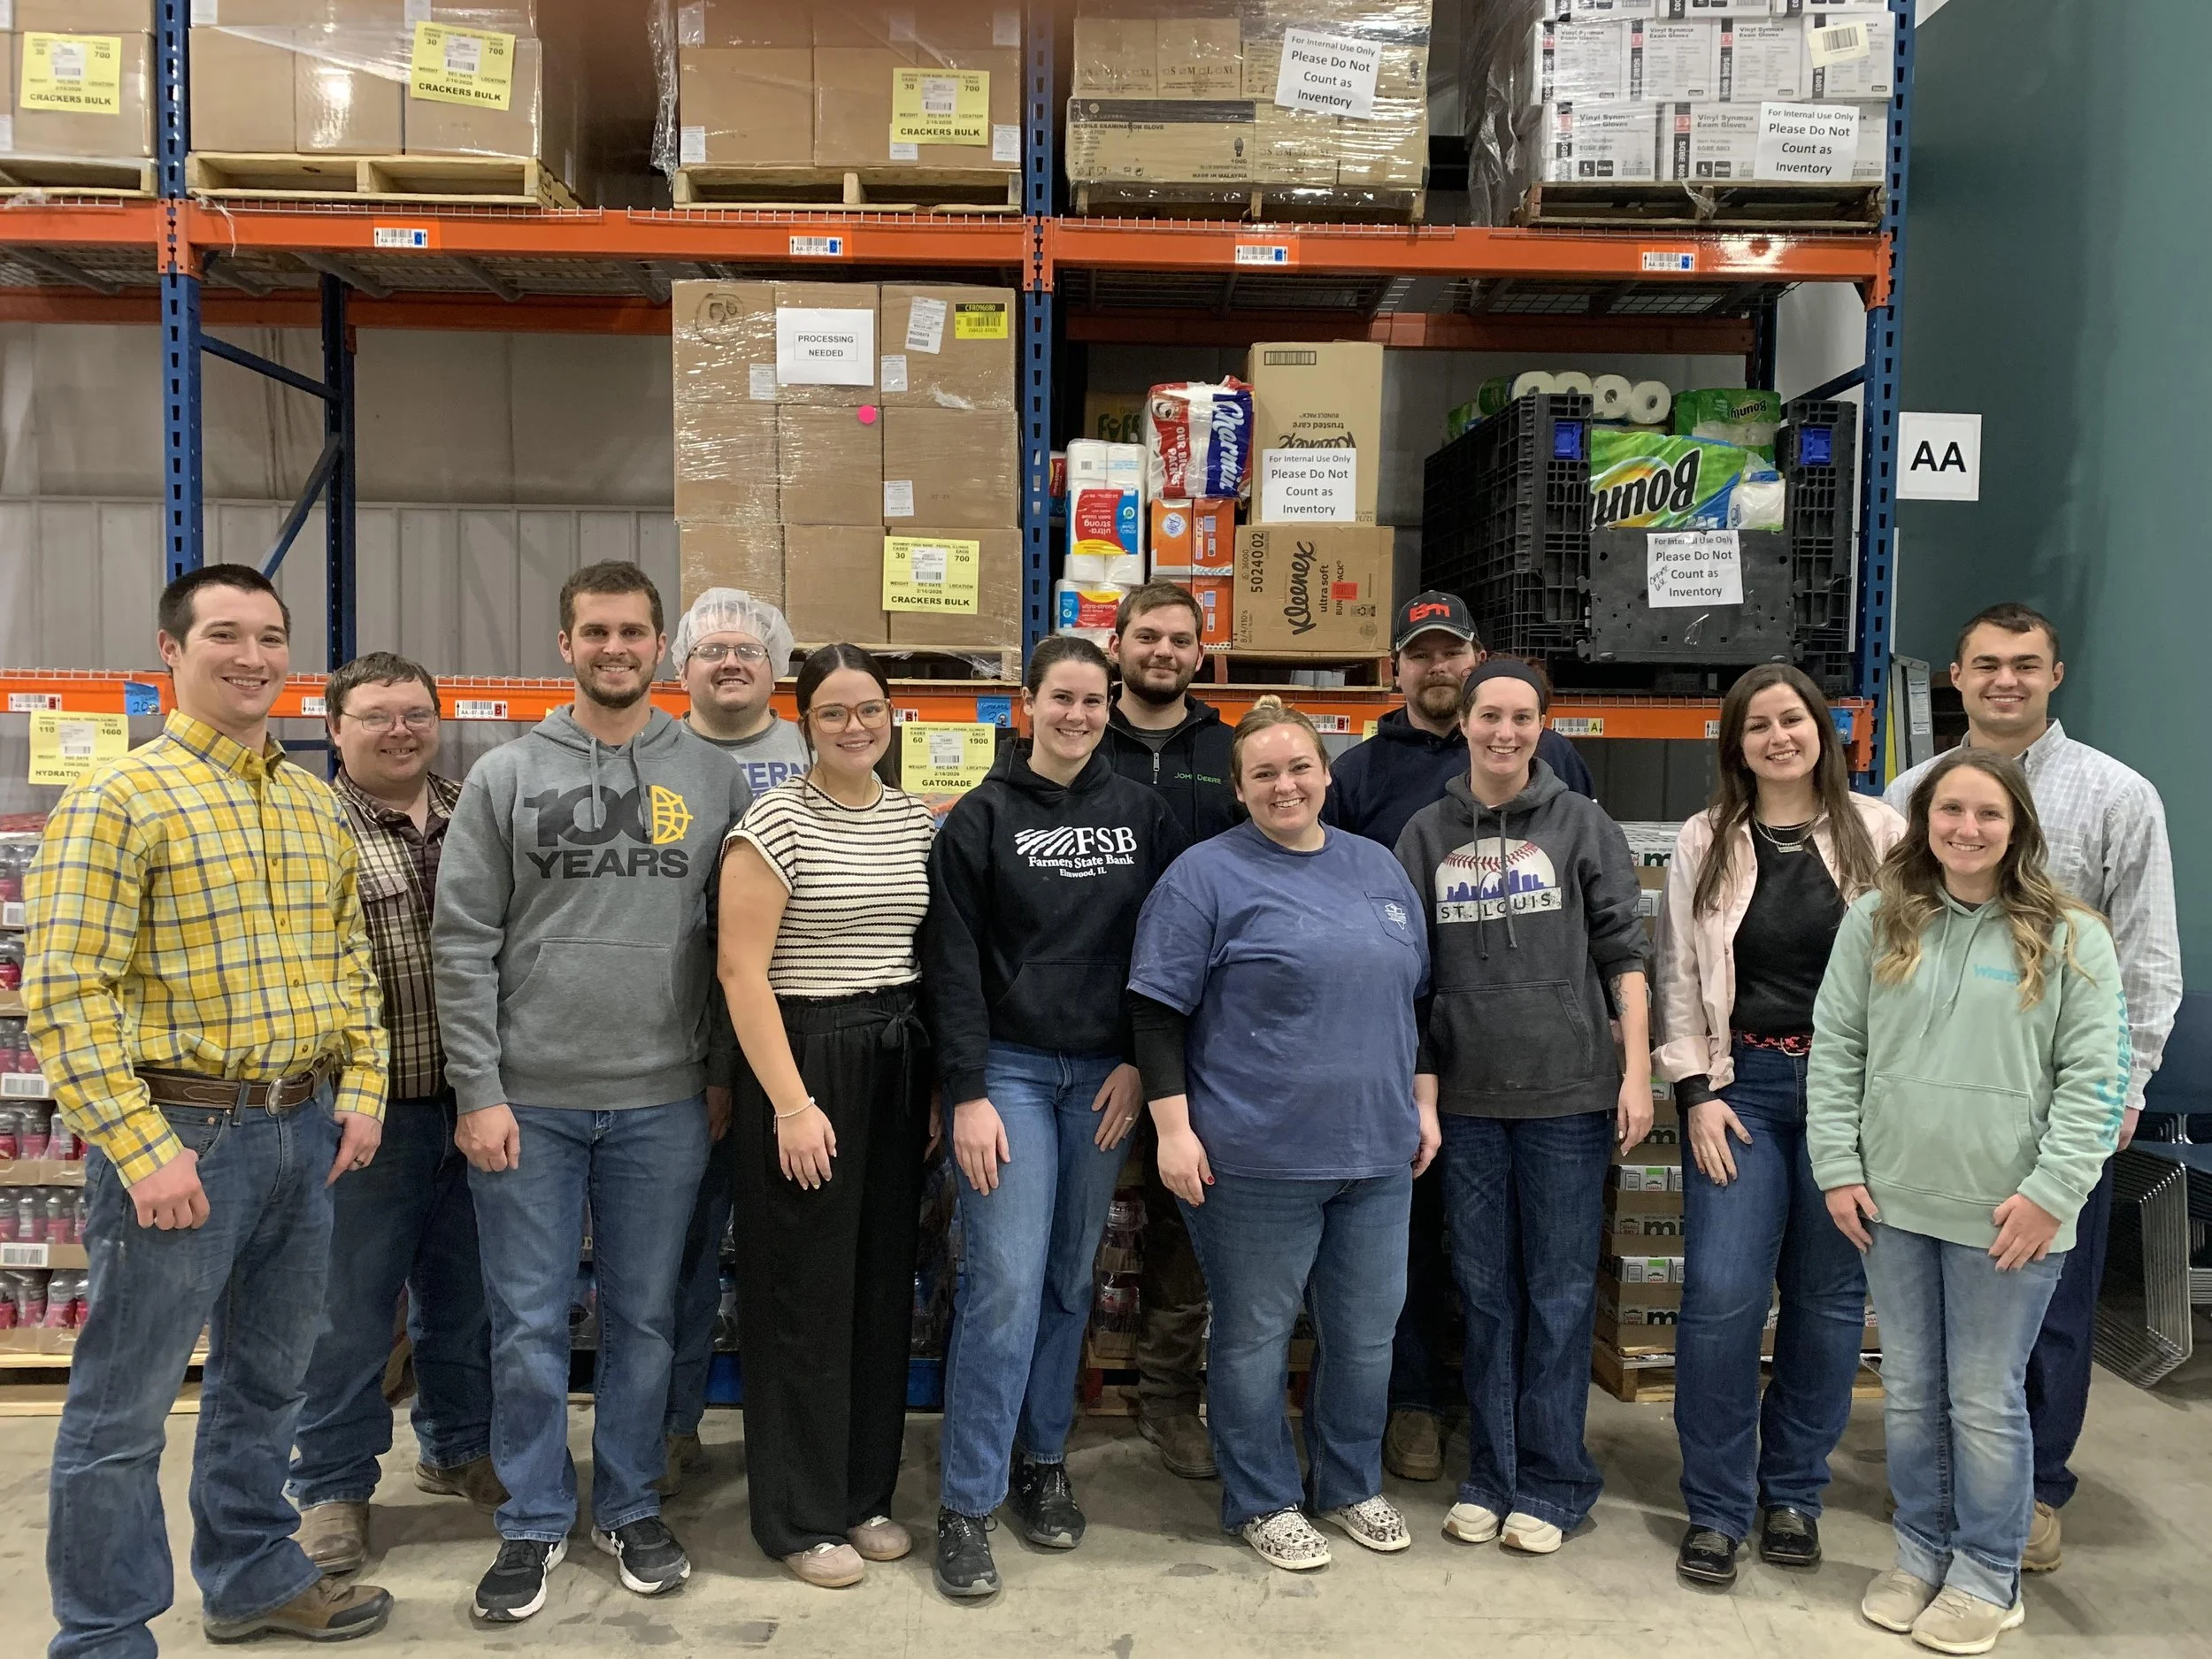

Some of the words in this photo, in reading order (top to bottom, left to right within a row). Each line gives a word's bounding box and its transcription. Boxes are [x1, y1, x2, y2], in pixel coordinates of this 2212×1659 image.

[1292, 36, 1305, 44] For
[1307, 38, 1338, 50] Internal
[1340, 43, 1355, 52] Use
[1356, 46, 1376, 57] Only
[1291, 50, 1328, 65] Please
[1331, 57, 1346, 68] Do
[1349, 60, 1371, 73] Not
[1303, 72, 1337, 86] Count
[1340, 79, 1352, 88] as
[30, 93, 82, 104] CRACKERS
[84, 96, 112, 105] BULK
[419, 83, 472, 96] CRACKERS
[474, 91, 502, 101] BULK
[1297, 89, 1353, 109] Inventory
[1784, 110, 1814, 118] Internal
[1835, 112, 1854, 122] Only
[1769, 123, 1806, 134] Please
[1809, 126, 1825, 135] Do
[1829, 127, 1851, 137] Not
[1782, 142, 1817, 154] Count
[1819, 146, 1832, 154] as
[1776, 162, 1832, 176] Inventory
[798, 335, 854, 343] PROCESSING
[1730, 399, 1767, 419] Bounty
[1175, 426, 1186, 450] OUR
[1213, 401, 1245, 490] Charmin
[1332, 455, 1351, 464] Only
[1910, 440, 1966, 472] AA
[1271, 469, 1306, 479] Please
[1310, 469, 1325, 479] Do
[1328, 469, 1348, 479] Not
[1286, 487, 1318, 496] Count
[1283, 504, 1336, 515] Inventory
[1083, 519, 1111, 528] strong
[1716, 536, 1733, 545] Only
[1656, 552, 1691, 561] Please
[1694, 551, 1709, 561] Do
[1713, 550, 1732, 560] Not
[1319, 565, 1329, 586] soft
[1649, 565, 1670, 585] OFFICE
[1671, 569, 1704, 579] Count
[1283, 541, 1317, 636] Kleenex
[1669, 587, 1722, 598] Inventory
[891, 596, 942, 605] CRACKERS
[1319, 588, 1328, 613] ultra
[1591, 722, 1598, 732] A
[1197, 774, 1221, 785] DEERE
[1075, 826, 1137, 856] FSB
[525, 848, 689, 879] YEARS
[1028, 856, 1073, 868] Farmers
[1074, 855, 1103, 868] State
[1106, 854, 1135, 865] Bank
[1060, 868, 1096, 879] Elmwood,
[1441, 905, 1473, 919] ST.
[1483, 893, 1551, 917] LOUIS
